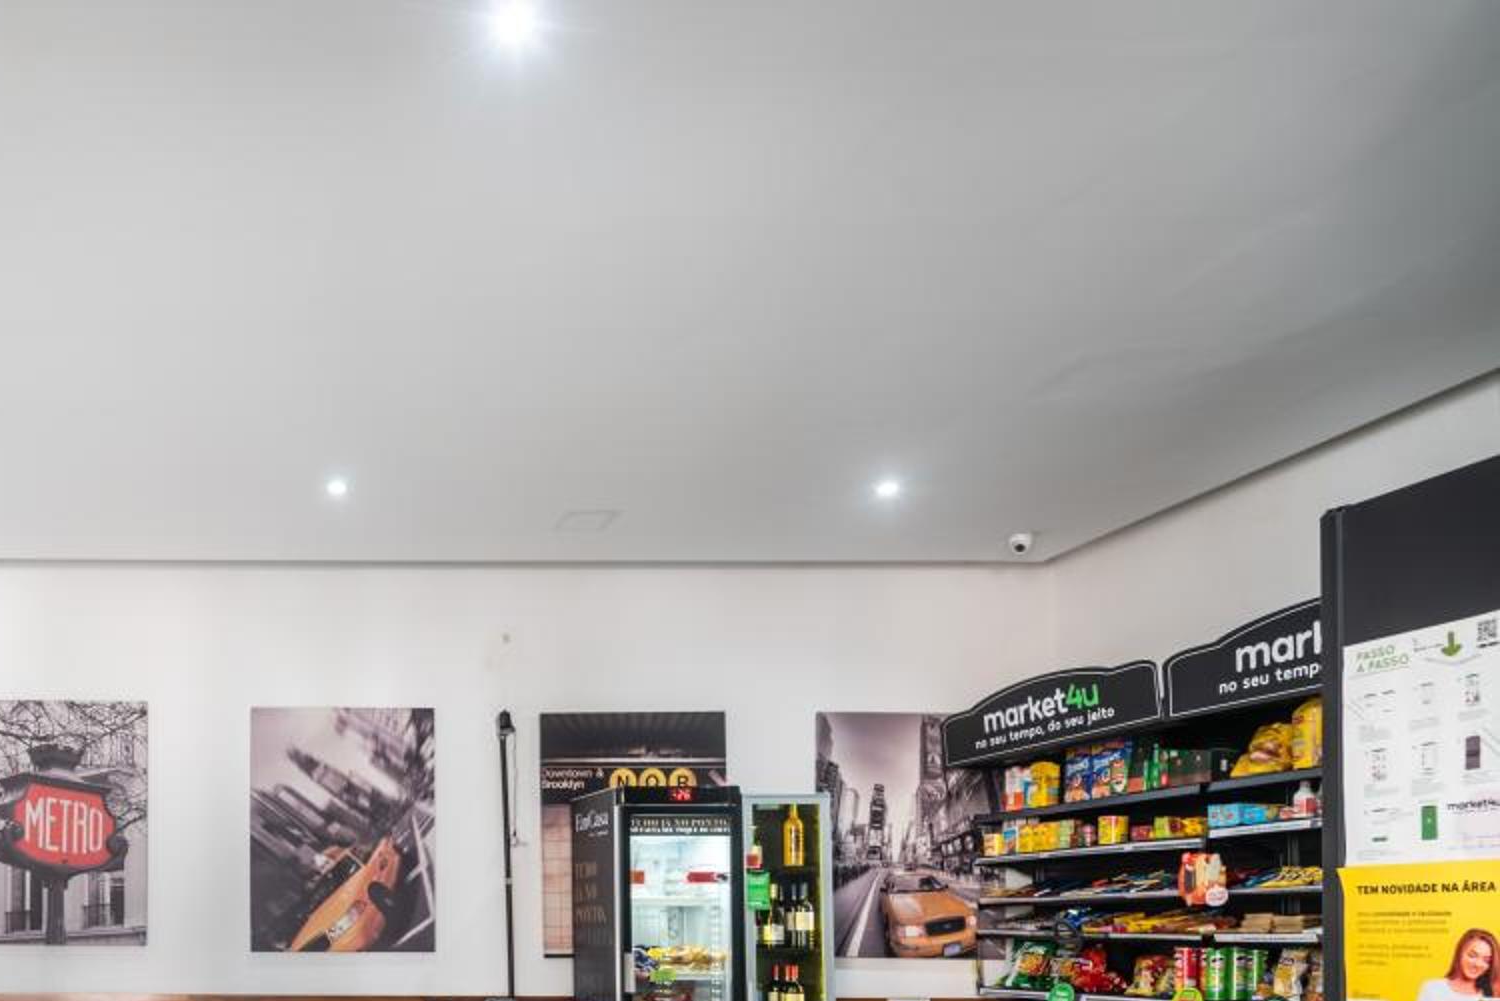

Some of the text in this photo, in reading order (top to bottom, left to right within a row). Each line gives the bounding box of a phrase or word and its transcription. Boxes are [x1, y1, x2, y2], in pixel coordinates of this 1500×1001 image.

[1218, 662, 1321, 694] no seu temp
[975, 740, 988, 749] no
[989, 735, 1008, 747] seu
[1064, 714, 1085, 728] seu
[541, 777, 585, 790] Brooklyn
[25, 796, 104, 856] METRO
[1357, 879, 1496, 895] TEM NOVIDADE NA ÁREA
